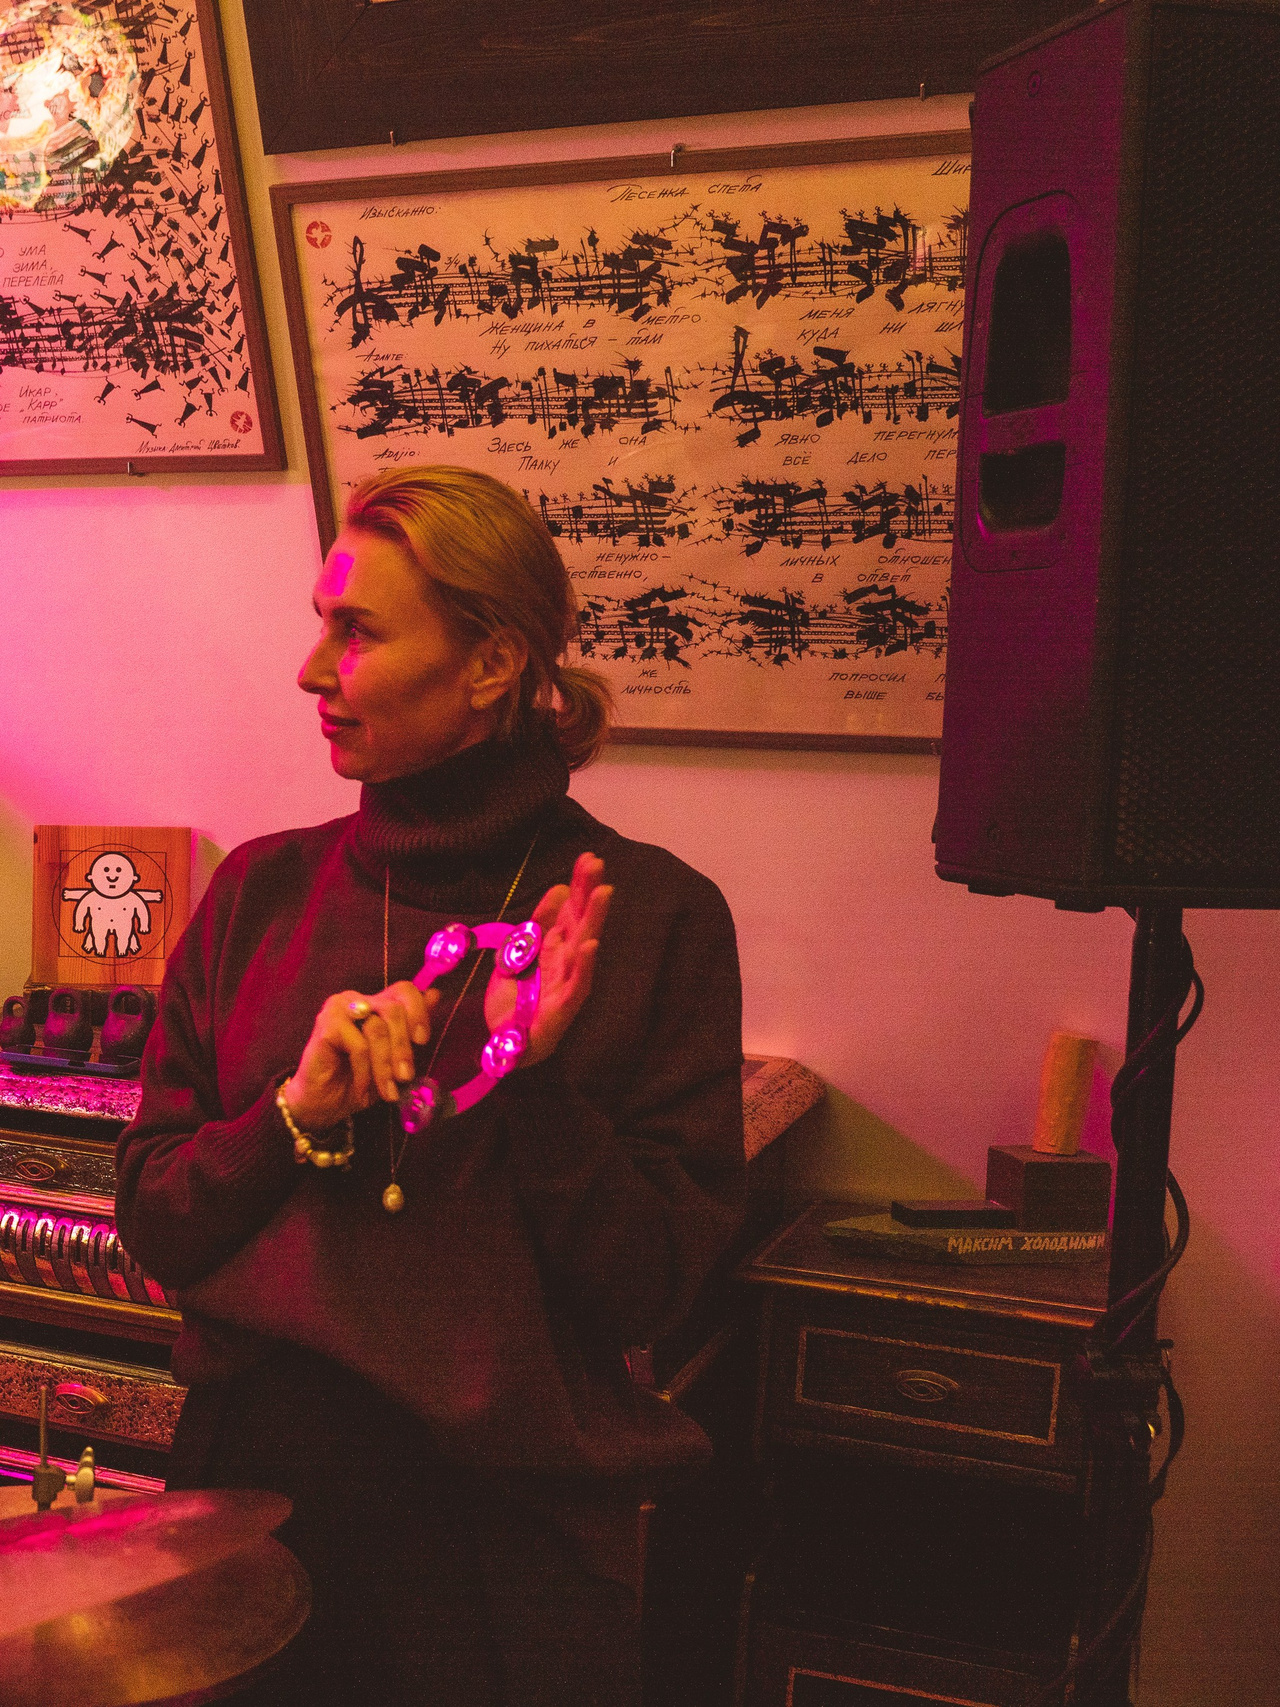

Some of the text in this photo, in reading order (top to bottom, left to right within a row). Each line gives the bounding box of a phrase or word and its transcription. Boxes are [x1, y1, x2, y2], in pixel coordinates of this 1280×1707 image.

[606, 174, 763, 203] ПЕСЕНКА СПЕТА
[18, 244, 47, 257] УМА
[799, 307, 856, 321] МЕНЯ
[479, 320, 564, 337] ЖЕНЩИНА
[582, 318, 596, 329] В
[797, 327, 840, 346] КУДА
[878, 322, 908, 335] НИ
[489, 338, 521, 360] НУ
[525, 332, 598, 351] ПИХАТЬСЯ
[486, 436, 648, 455] ЗДЕСЬ ЖЕ ОНА
[774, 432, 821, 447] ЯВНО
[517, 455, 619, 477] ПАЛКУ И
[782, 450, 813, 467] ВСЁ
[846, 451, 889, 465] ДЕЛО
[779, 554, 841, 567] ЛИЧНЫХ
[812, 566, 920, 584] В ОТВЕТ
[637, 668, 658, 679] ЖЕ
[827, 671, 908, 684] ПОПРОСИЛ
[620, 680, 692, 695] ЛИЧНОСТЬ
[843, 689, 888, 701] ВЫШЕ
[946, 1236, 1013, 1254] МАКСИМ
